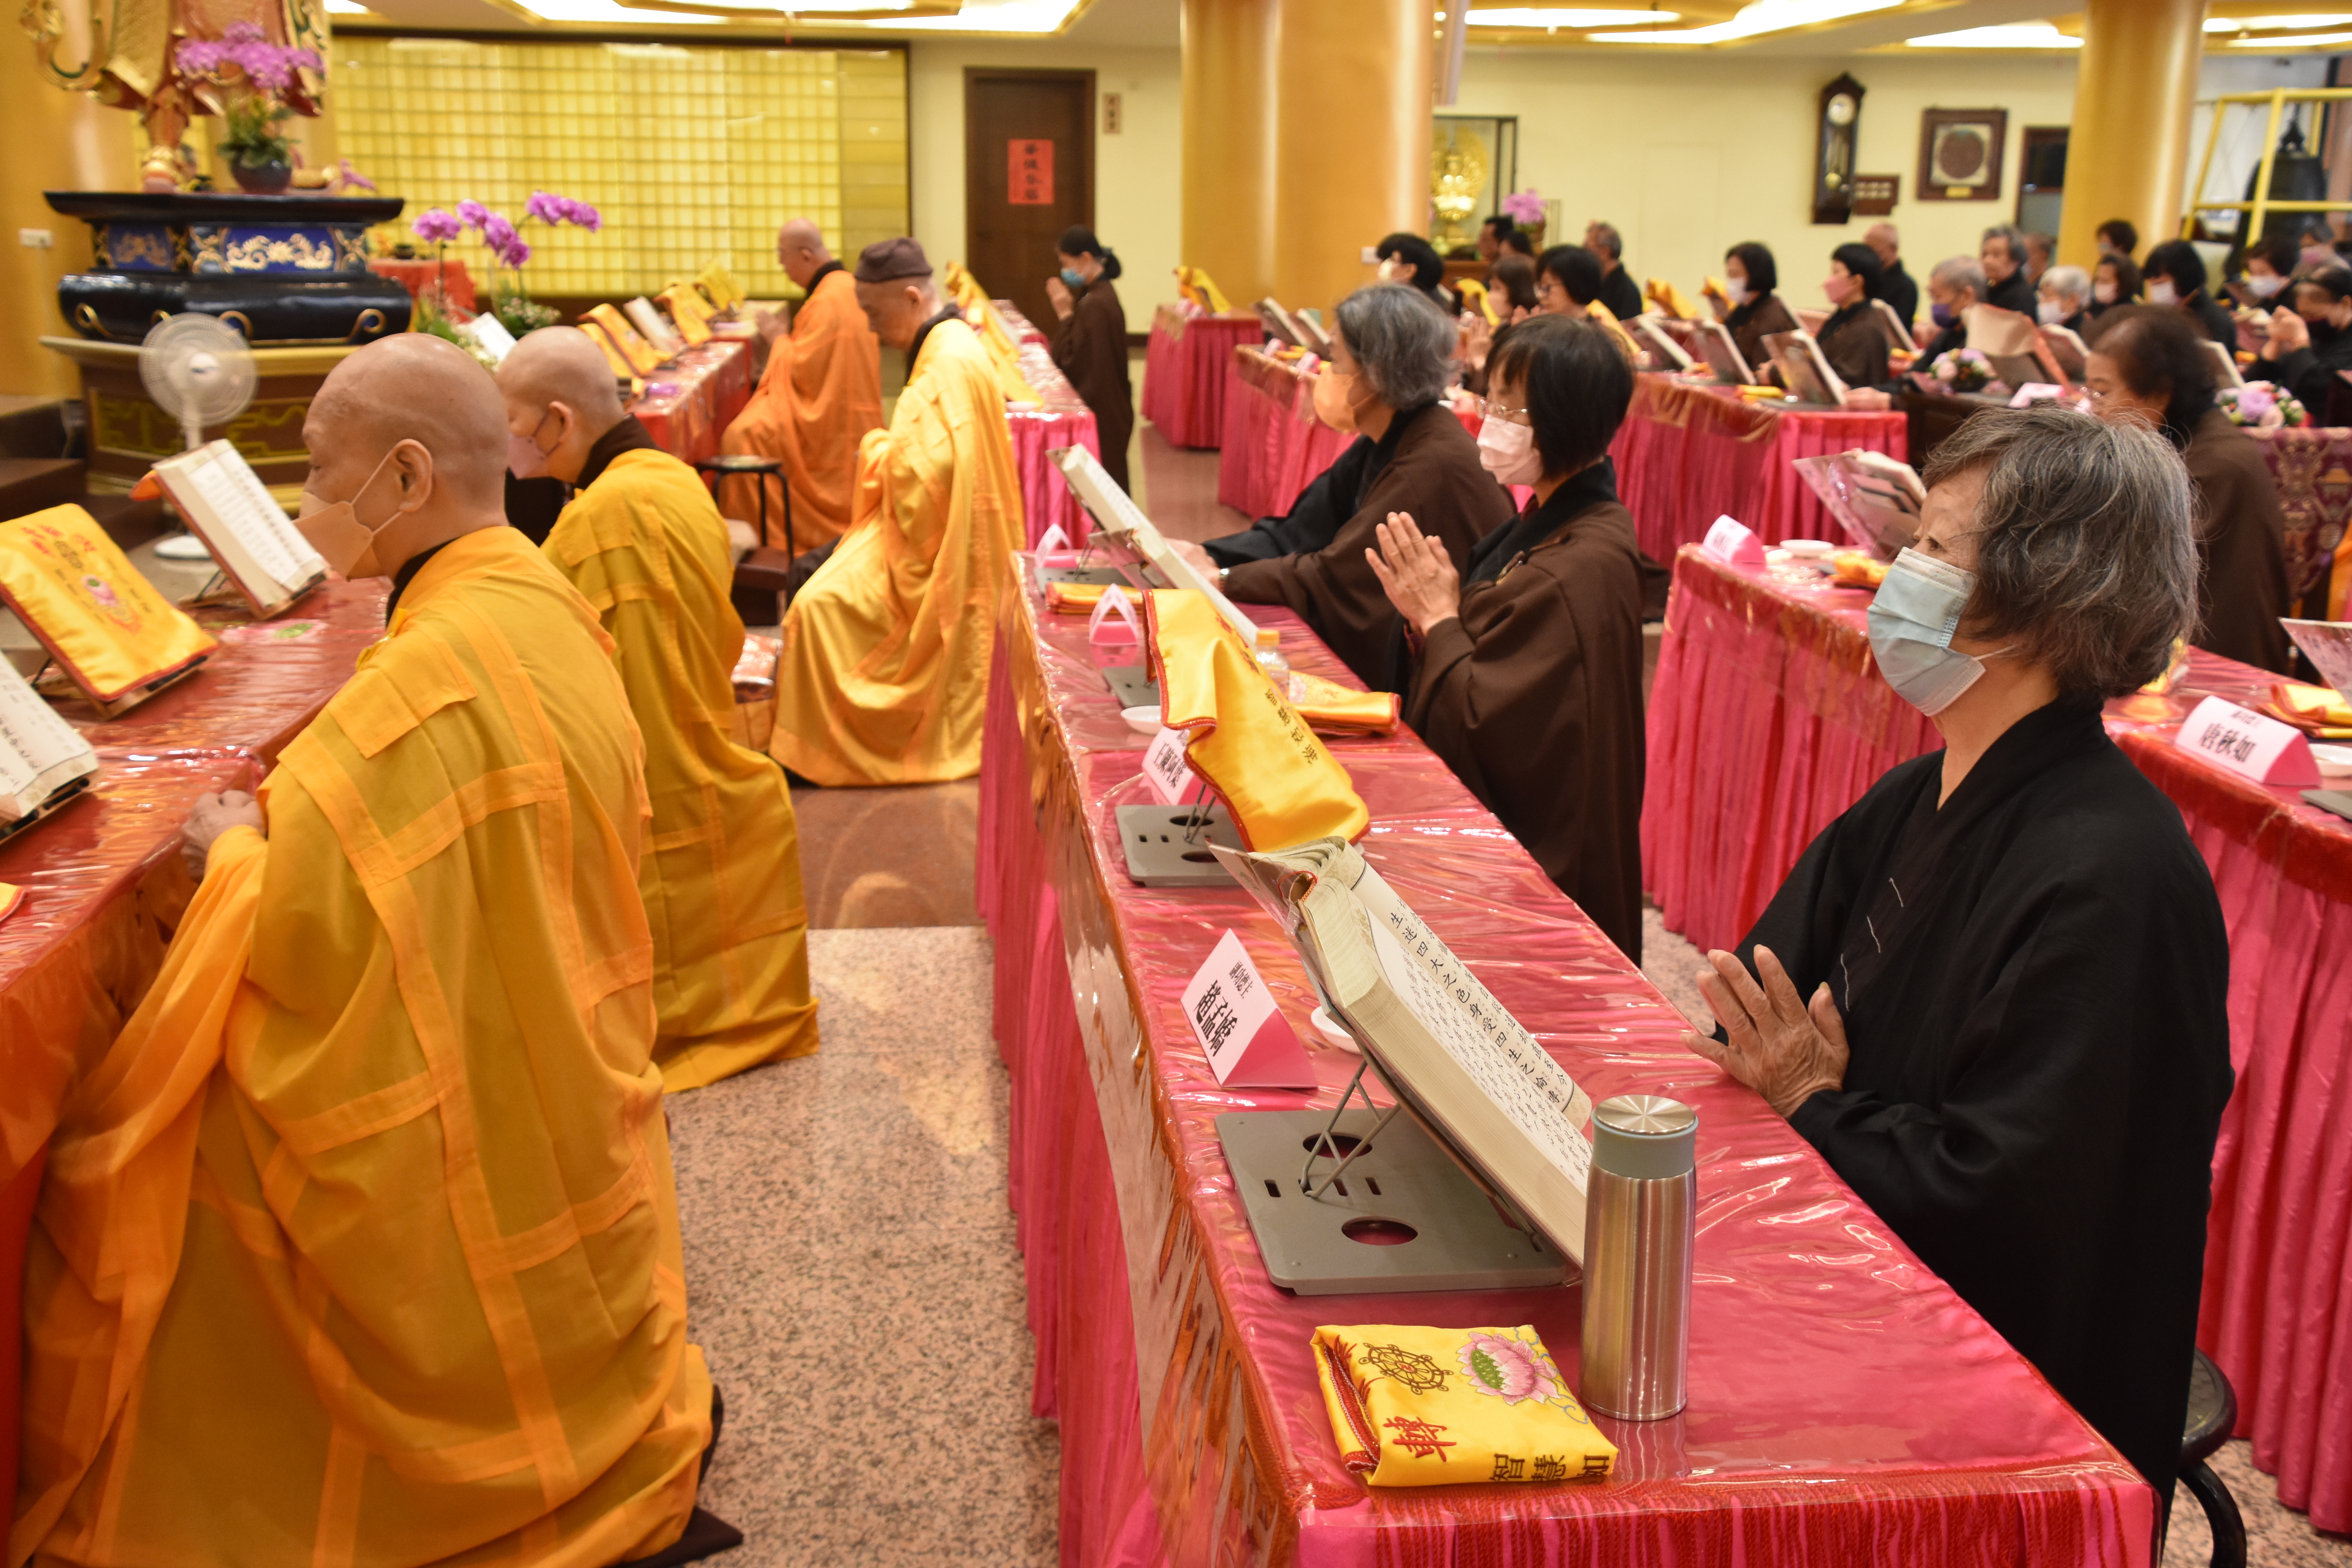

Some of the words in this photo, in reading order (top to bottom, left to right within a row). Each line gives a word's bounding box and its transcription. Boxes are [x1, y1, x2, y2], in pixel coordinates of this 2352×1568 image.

[1264, 688, 1318, 765] 智慧如海
[1192, 979, 1238, 1057] 趙孟嬌
[1229, 960, 1254, 999] 副功德主
